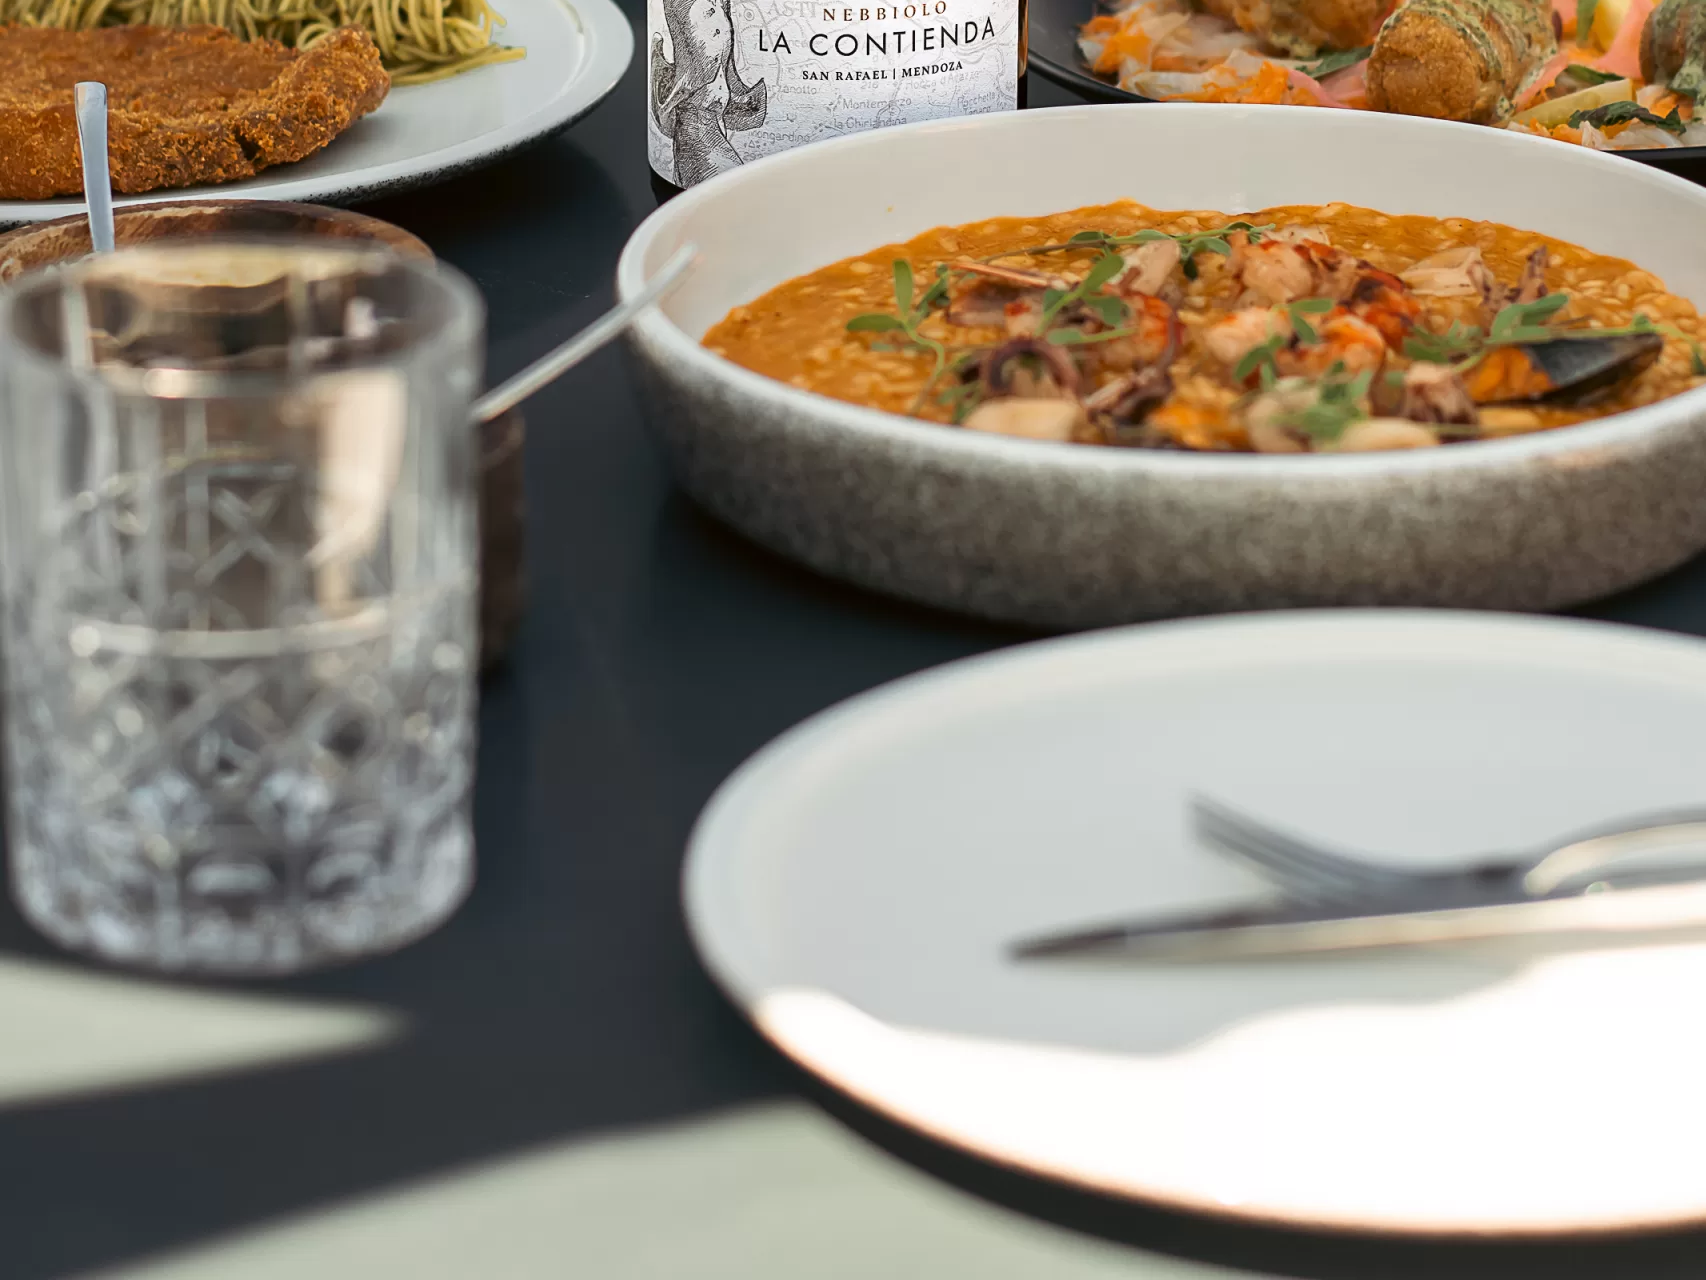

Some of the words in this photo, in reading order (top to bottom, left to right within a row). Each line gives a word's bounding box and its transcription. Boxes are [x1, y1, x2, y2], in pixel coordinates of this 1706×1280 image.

[824, 1, 946, 21] NEBBIOLO
[760, 29, 791, 54] LA
[810, 16, 994, 56] CONTIENDA
[802, 70, 829, 81] SAN
[836, 69, 887, 81] RAFAEL
[902, 61, 962, 77] MENDOZA
